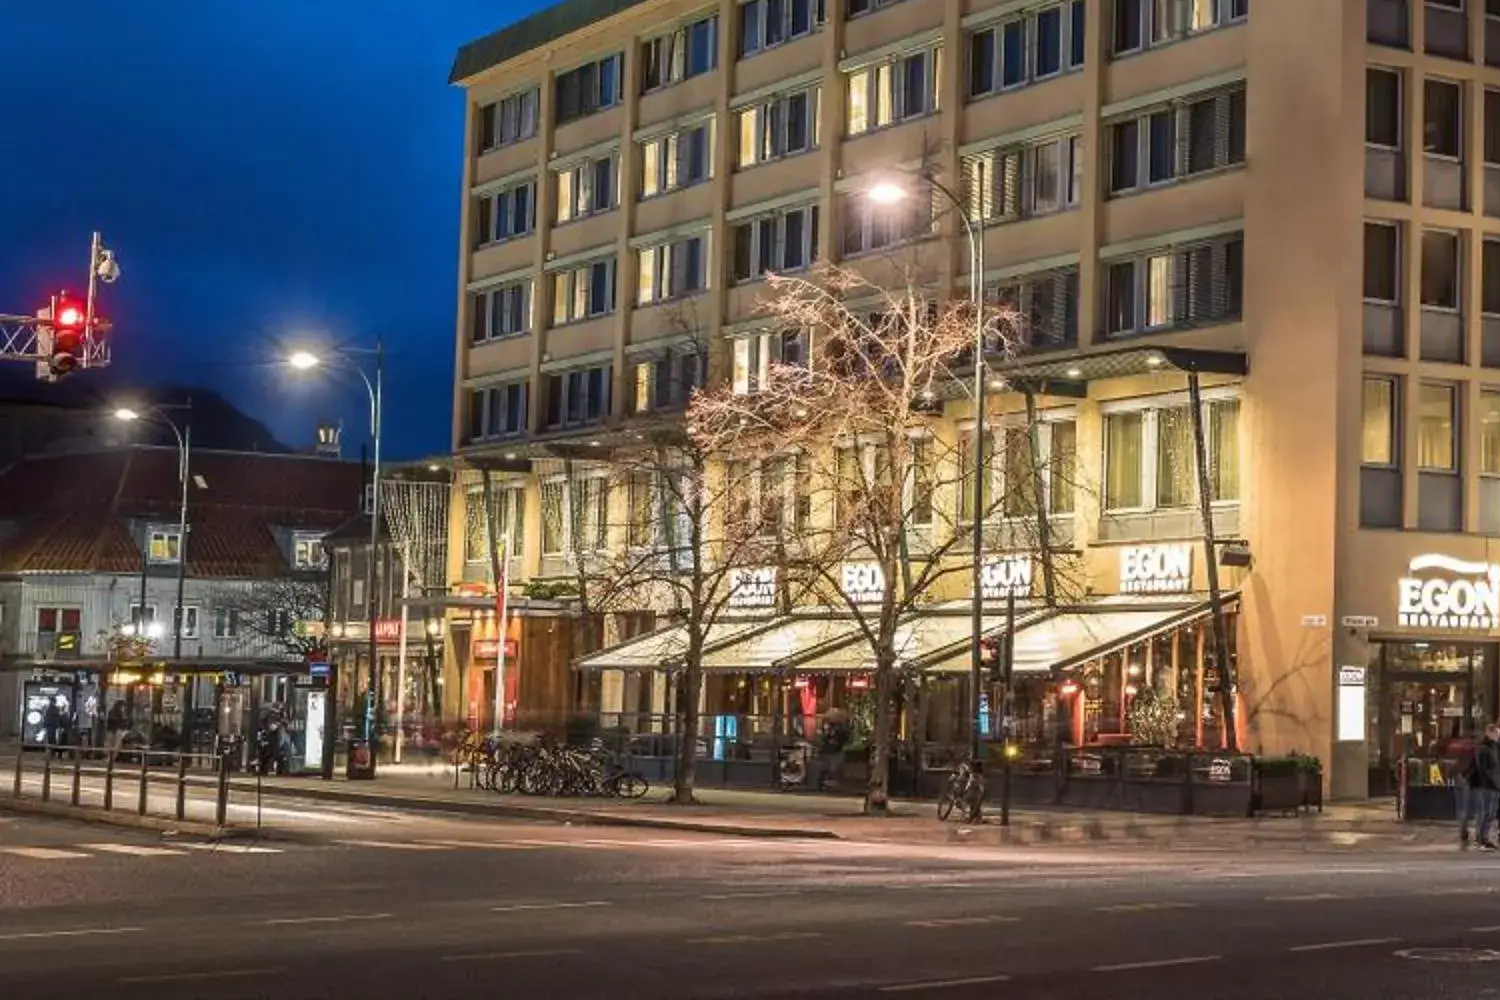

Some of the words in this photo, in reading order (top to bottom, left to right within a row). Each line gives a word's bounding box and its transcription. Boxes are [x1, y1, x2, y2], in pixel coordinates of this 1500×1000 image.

[842, 562, 885, 592] EGO
[978, 554, 1031, 584] GON
[1121, 545, 1191, 579] EGON
[1398, 613, 1500, 629] RESTAURANT
